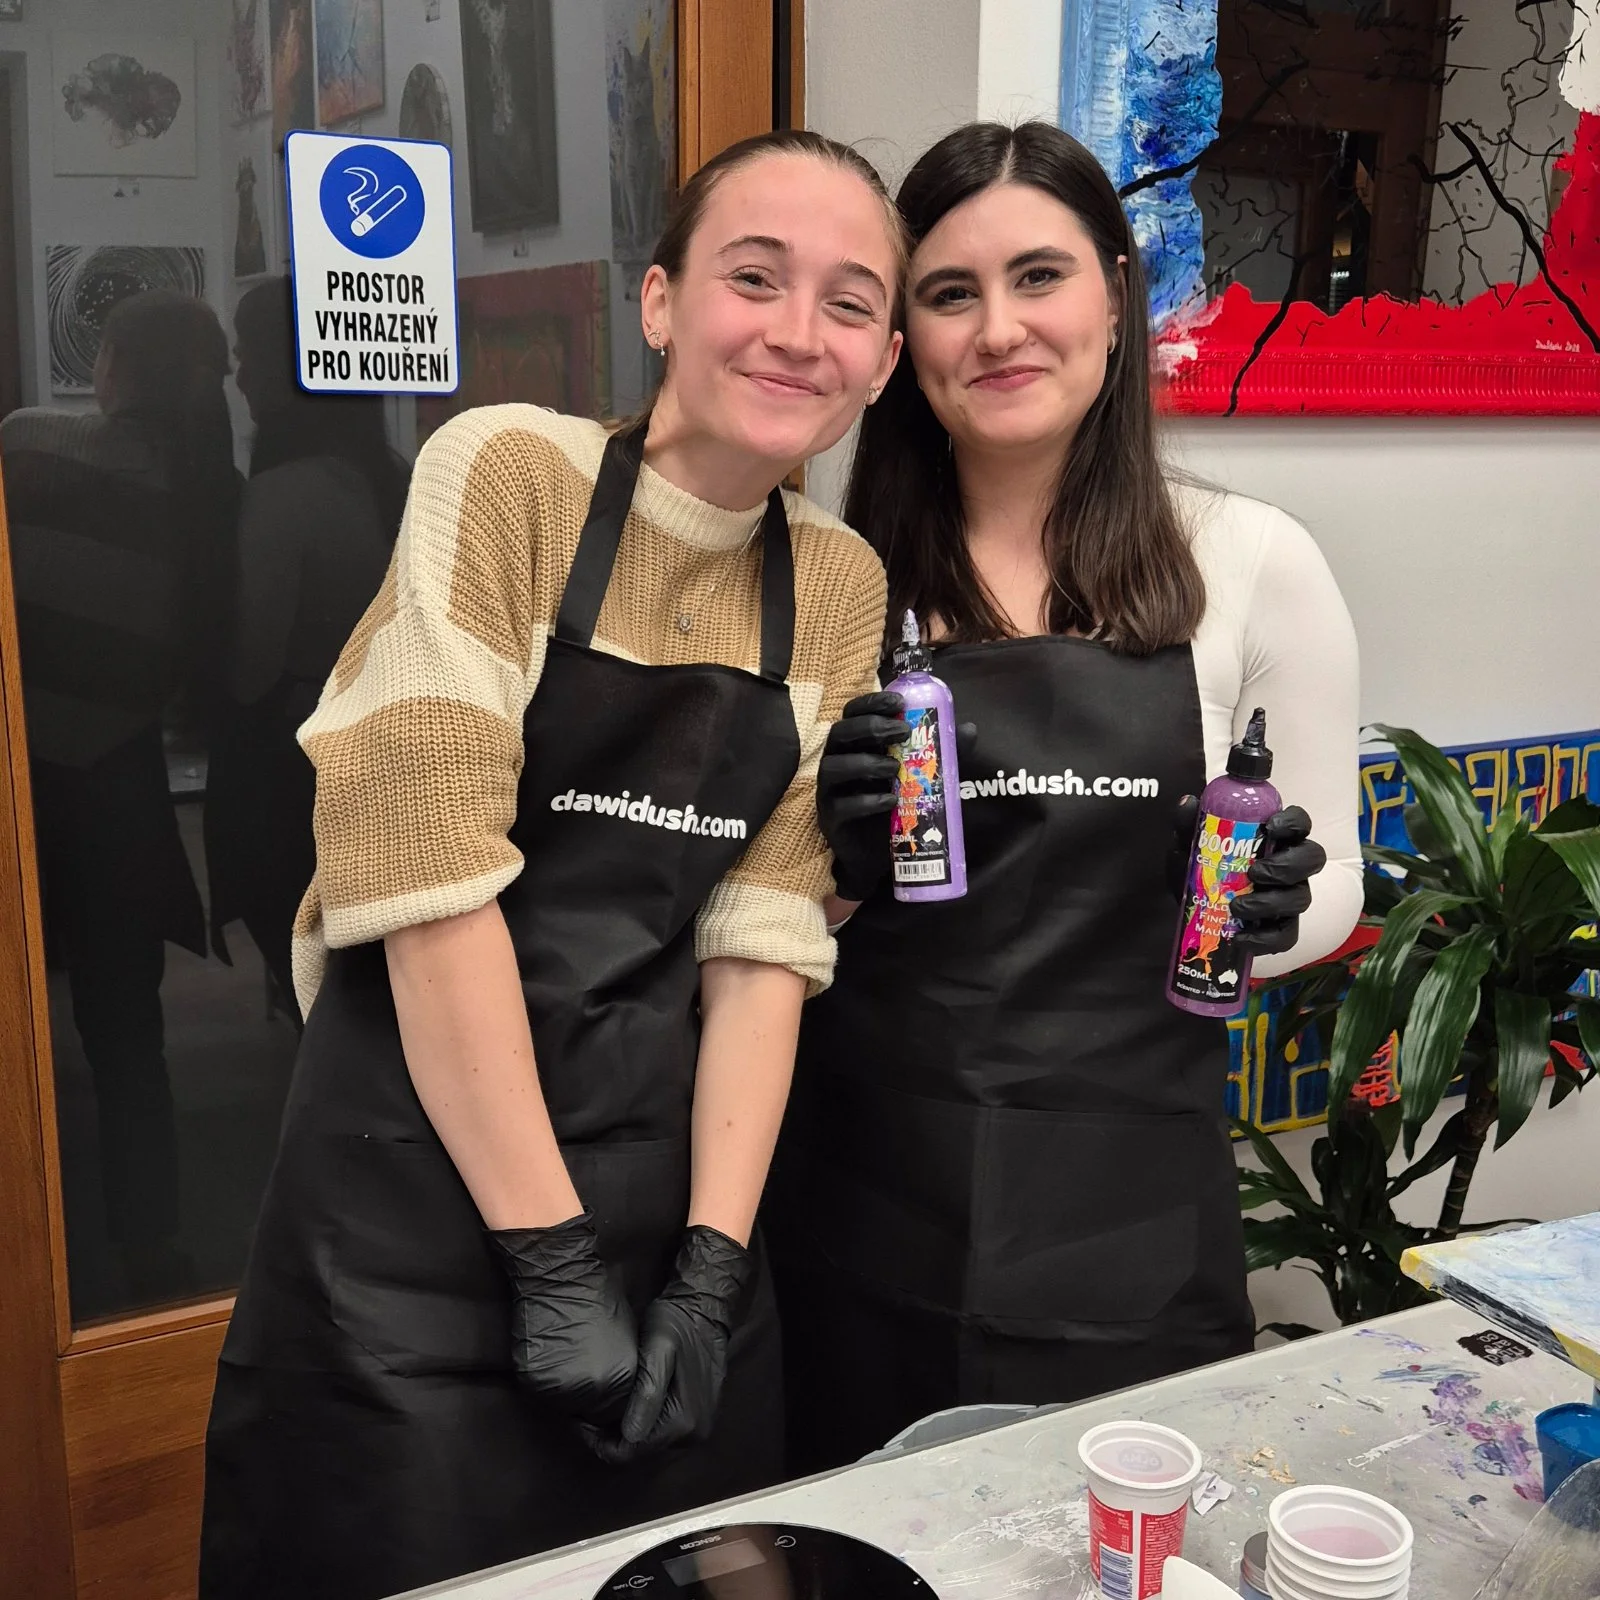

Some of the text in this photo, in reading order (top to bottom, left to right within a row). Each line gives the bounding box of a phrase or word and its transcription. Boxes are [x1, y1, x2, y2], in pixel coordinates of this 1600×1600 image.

[327, 270, 425, 305] PROSTOR
[315, 307, 438, 344] VYHRAZENÝ
[308, 346, 449, 382] PRO KOUŘENÍ
[959, 768, 1159, 800] awidush.com
[550, 789, 747, 839] dawidush.com
[1198, 830, 1263, 859] BOOM!
[1195, 923, 1236, 938] MAUVE
[1178, 963, 1212, 981] 250ML
[679, 1534, 722, 1550] SENCOR
